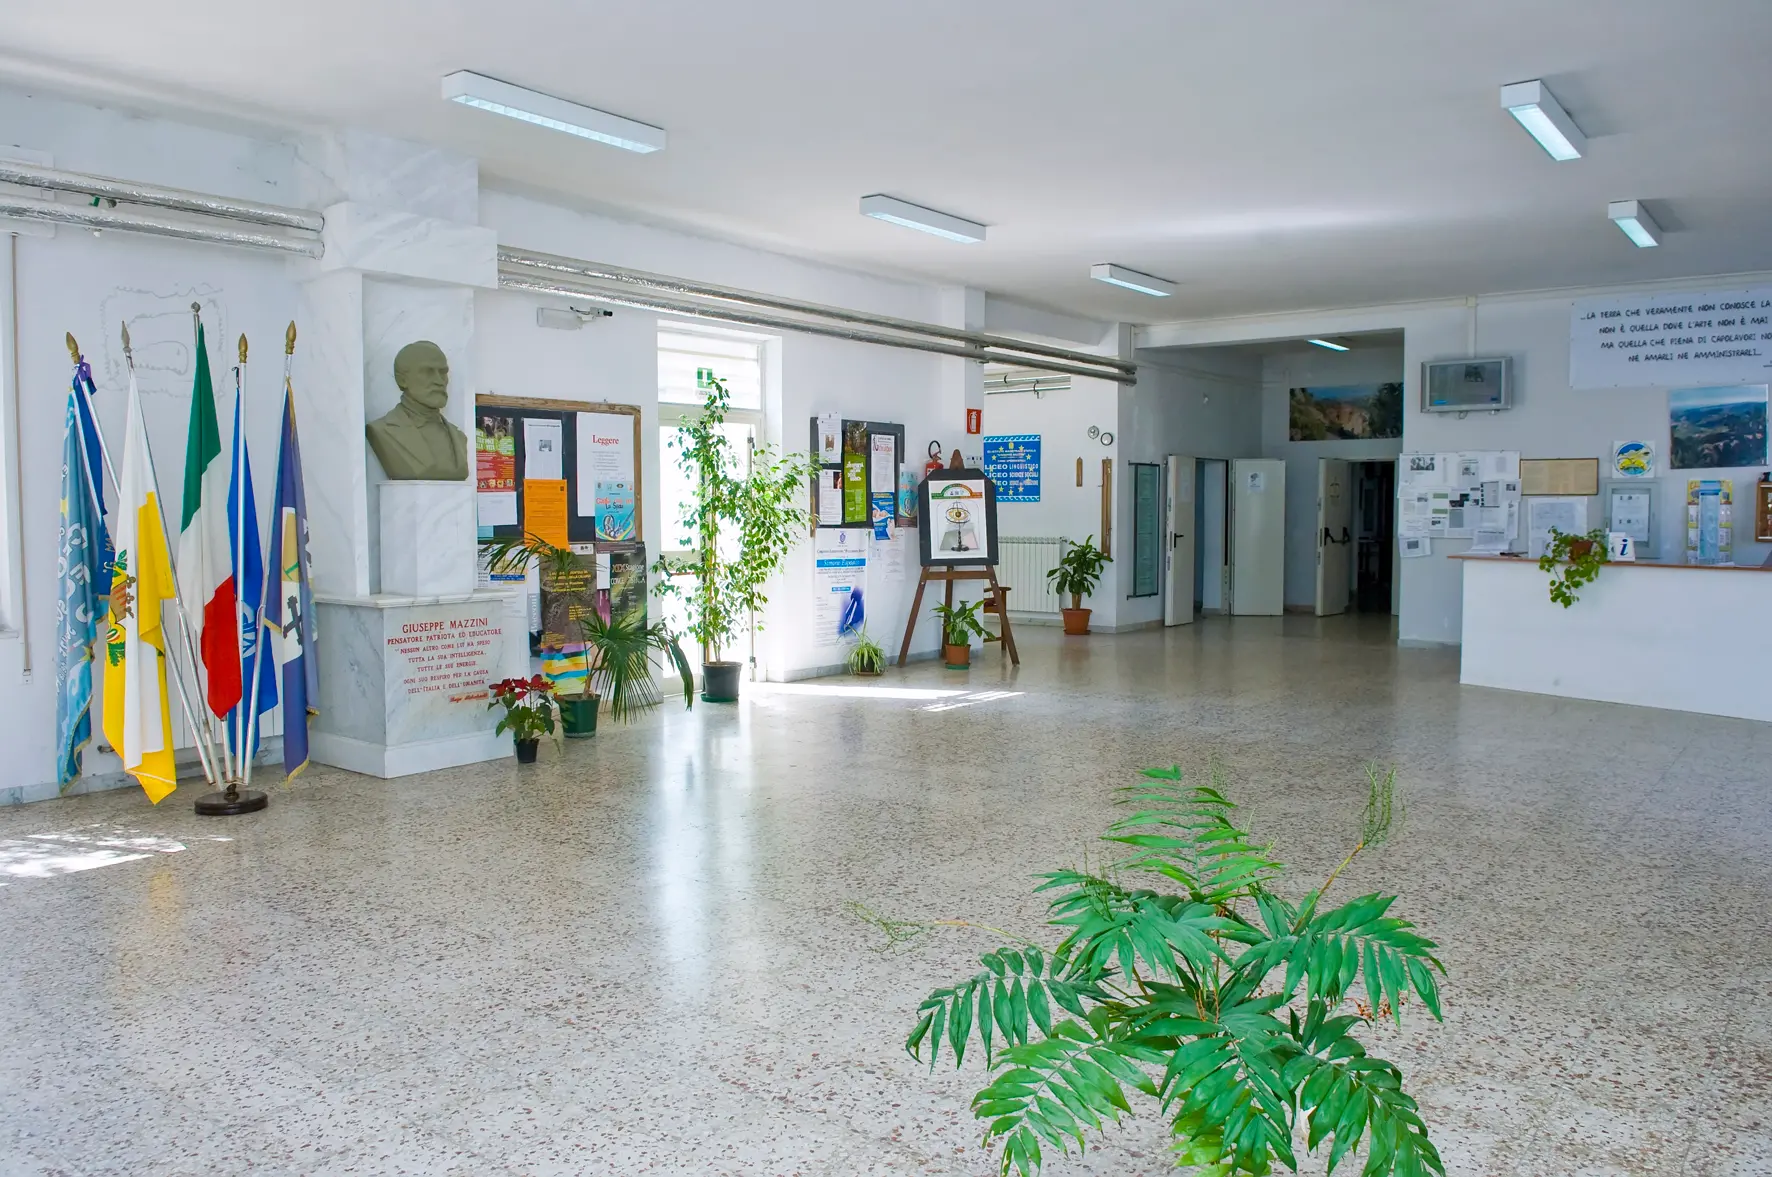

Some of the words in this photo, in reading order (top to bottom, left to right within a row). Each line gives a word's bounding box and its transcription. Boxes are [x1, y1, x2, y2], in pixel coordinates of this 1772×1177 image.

[1600, 310, 1621, 318] TERRA
[1625, 309, 1640, 317] CHE
[1646, 305, 1693, 316] VERAMENTE
[1698, 304, 1716, 312] NON
[1720, 301, 1756, 310] CONOSCE
[1760, 300, 1770, 308] LA
[1599, 326, 1616, 334] NON
[1620, 324, 1625, 332] È
[1630, 324, 1659, 332] QUELLA
[1663, 322, 1683, 330] DOVE
[1688, 320, 1712, 328] L'ARTE
[1718, 318, 1735, 326] NON
[1740, 316, 1746, 324] È
[1751, 316, 1768, 324] MAI
[1600, 341, 1614, 349] MA
[1618, 340, 1647, 348] QUELLA
[1650, 338, 1665, 346] CHE
[1670, 337, 1694, 345] PIENA
[1711, 334, 1756, 343] CAPOLAVORI
[1644, 353, 1673, 361] AMARLI
[592, 434, 619, 446] Leggere
[402, 621, 444, 634] GIUSEPPE
[450, 618, 488, 629] MAZZINI
[387, 636, 423, 645] PENSATORE
[426, 633, 455, 642] PATRIOTA
[469, 628, 502, 637] EDUCATORE
[403, 677, 416, 685] OGNI
[430, 673, 451, 682] RESPIRO
